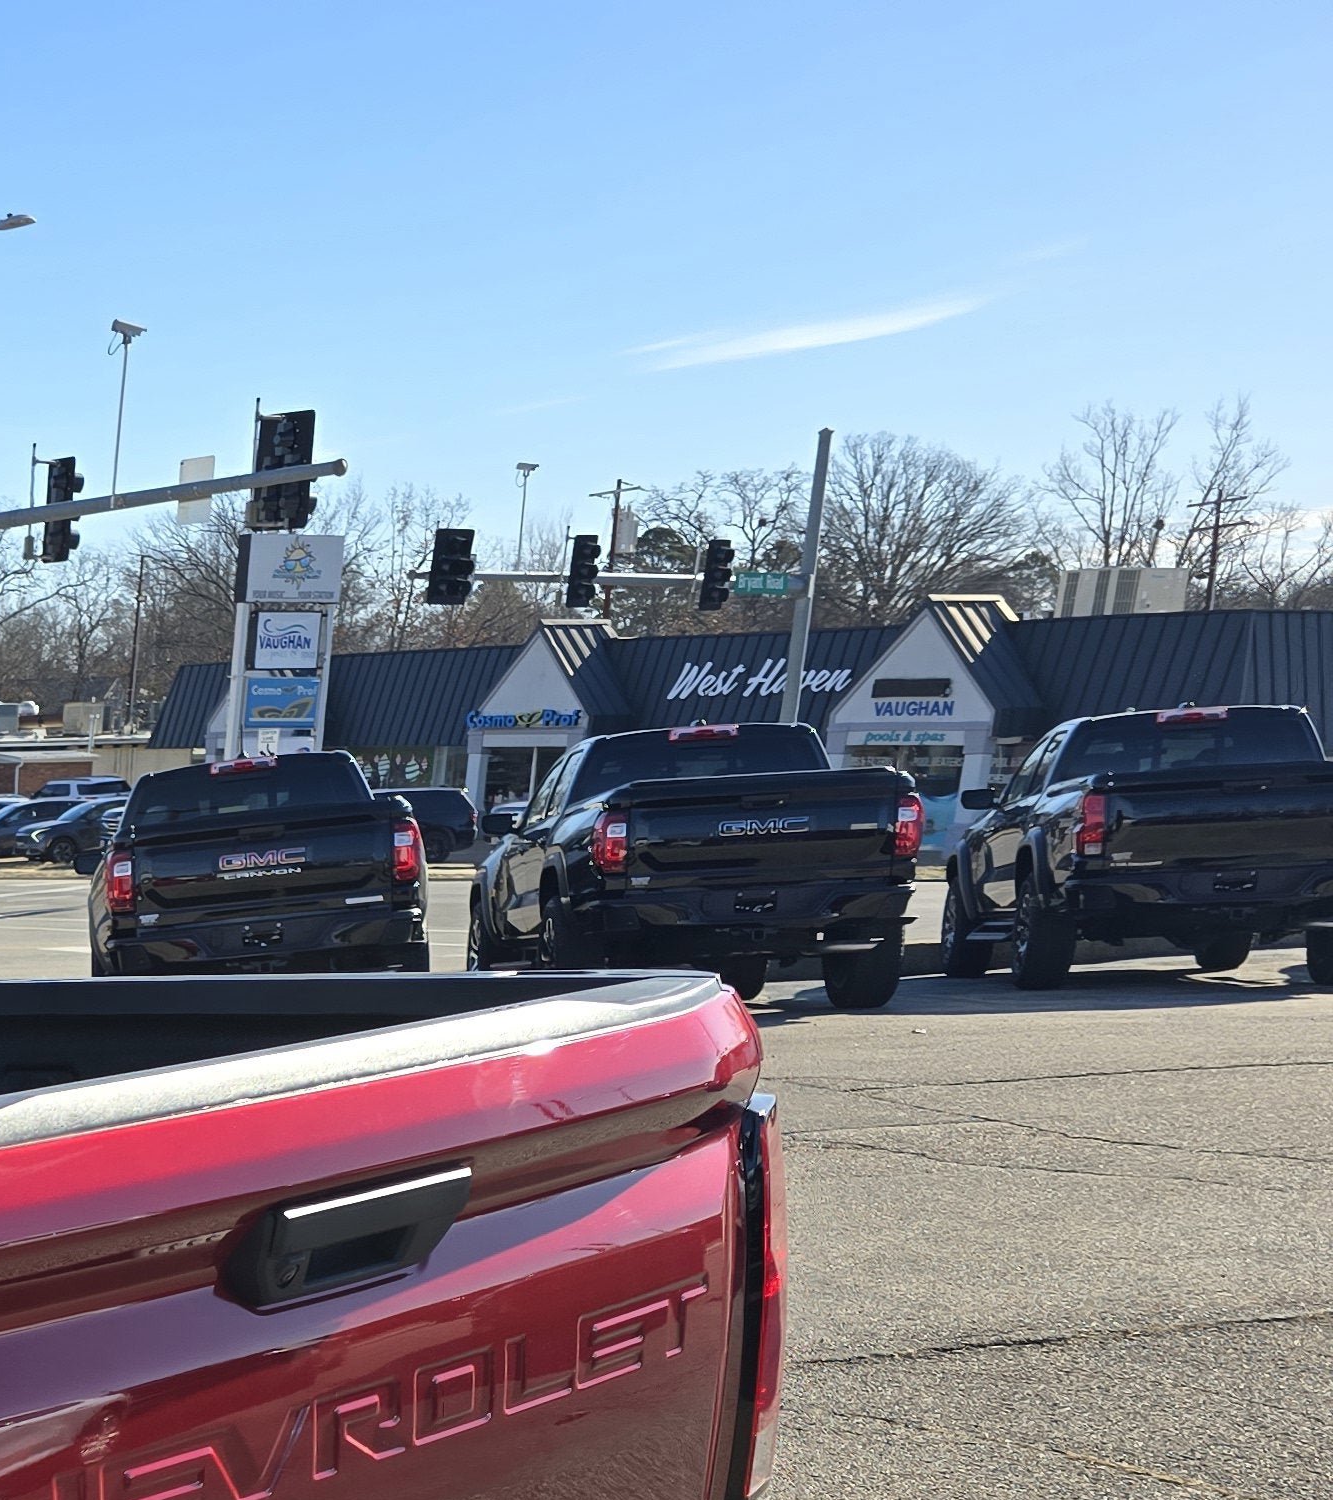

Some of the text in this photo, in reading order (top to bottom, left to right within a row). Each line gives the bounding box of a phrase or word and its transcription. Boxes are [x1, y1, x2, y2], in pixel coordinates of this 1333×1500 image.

[259, 635, 312, 649] VAUGHAN
[666, 661, 746, 700] West
[251, 685, 282, 696] Cosmo
[874, 701, 955, 717] VAUGHAN
[466, 709, 581, 728] Cosmo Prof
[865, 731, 900, 745] pools
[914, 732, 946, 745] spas
[718, 816, 809, 837] GMC
[218, 847, 306, 870] GMC
